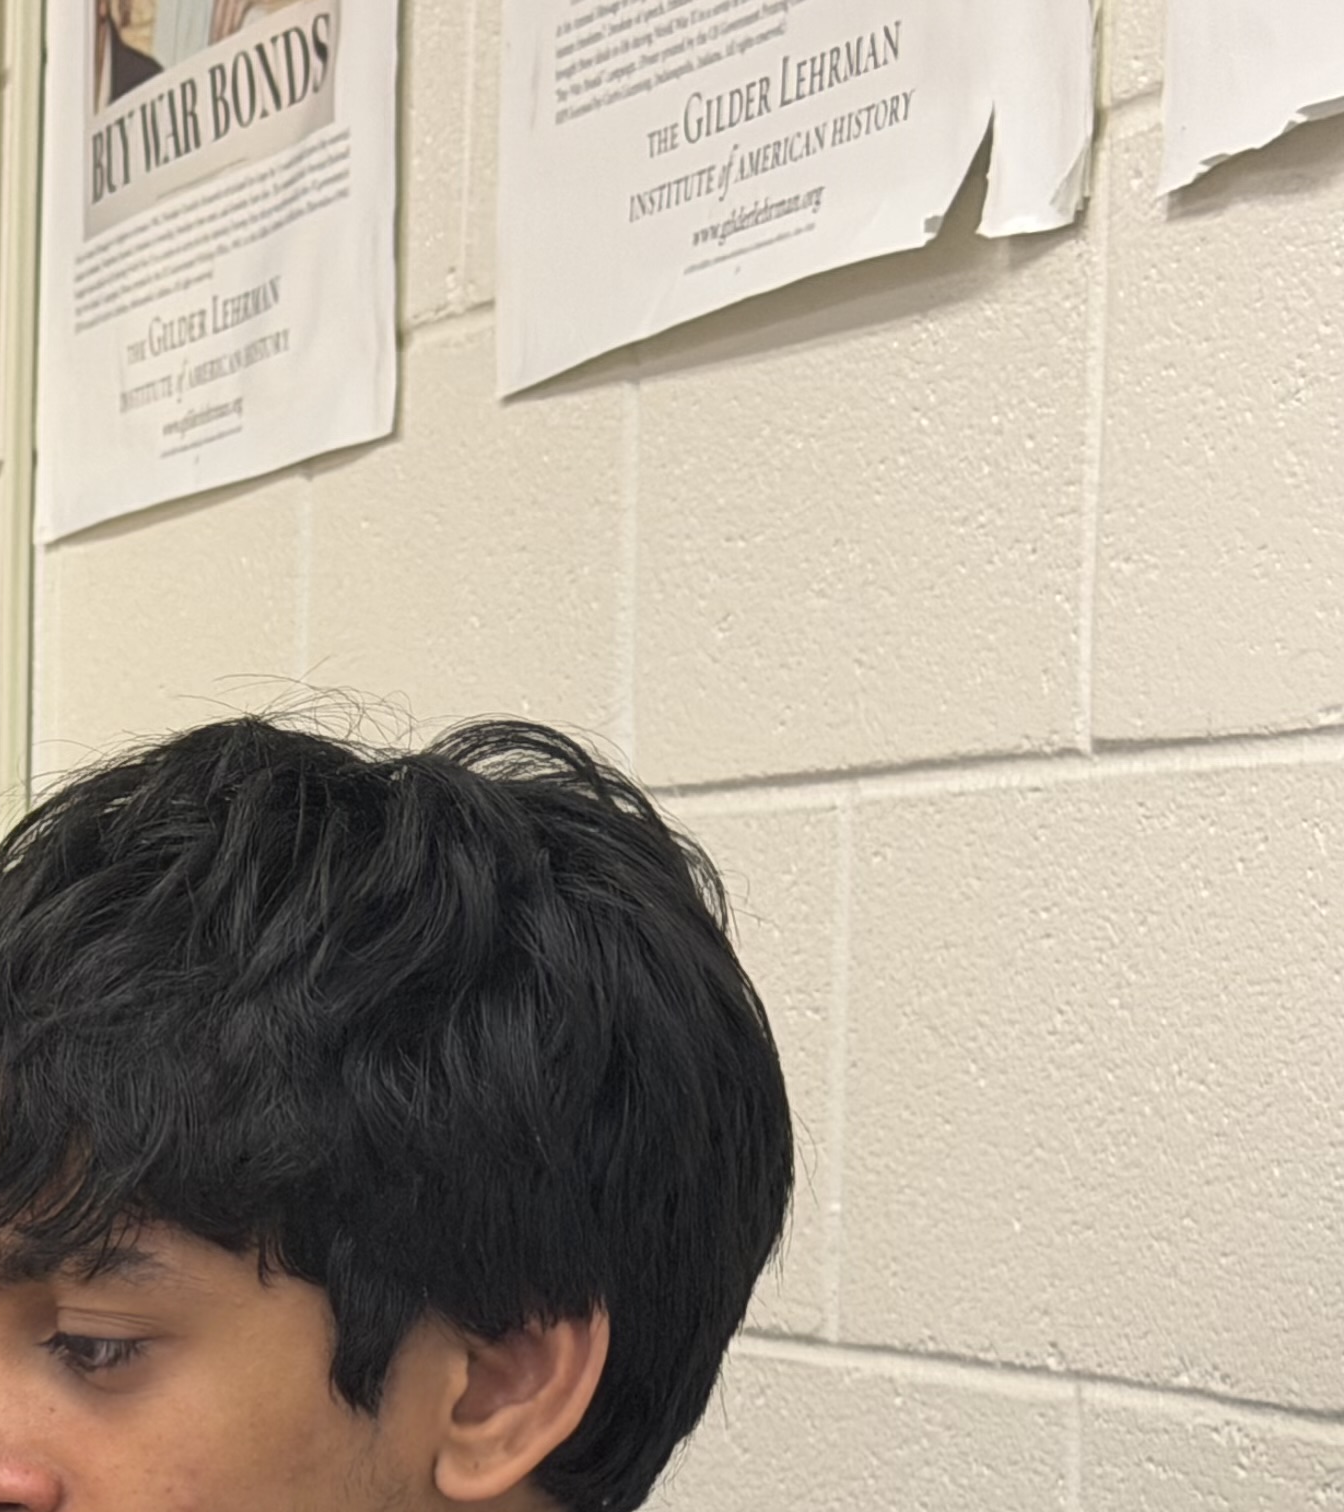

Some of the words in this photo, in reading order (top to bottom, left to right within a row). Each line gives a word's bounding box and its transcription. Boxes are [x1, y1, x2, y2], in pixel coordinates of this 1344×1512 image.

[91, 109, 135, 205] BUY
[140, 77, 202, 173] WAR
[208, 12, 331, 143] BONDS
[628, 164, 717, 223] INSTITUTE
[716, 143, 739, 202] of
[734, 121, 828, 185] AMERICAN
[830, 88, 916, 150] HISTORY
[647, 121, 680, 159] THE
[683, 74, 772, 144] GILDER
[778, 20, 902, 108] LEHRMAN
[148, 308, 208, 357] GILDER
[211, 274, 282, 335] LEHRMAN
